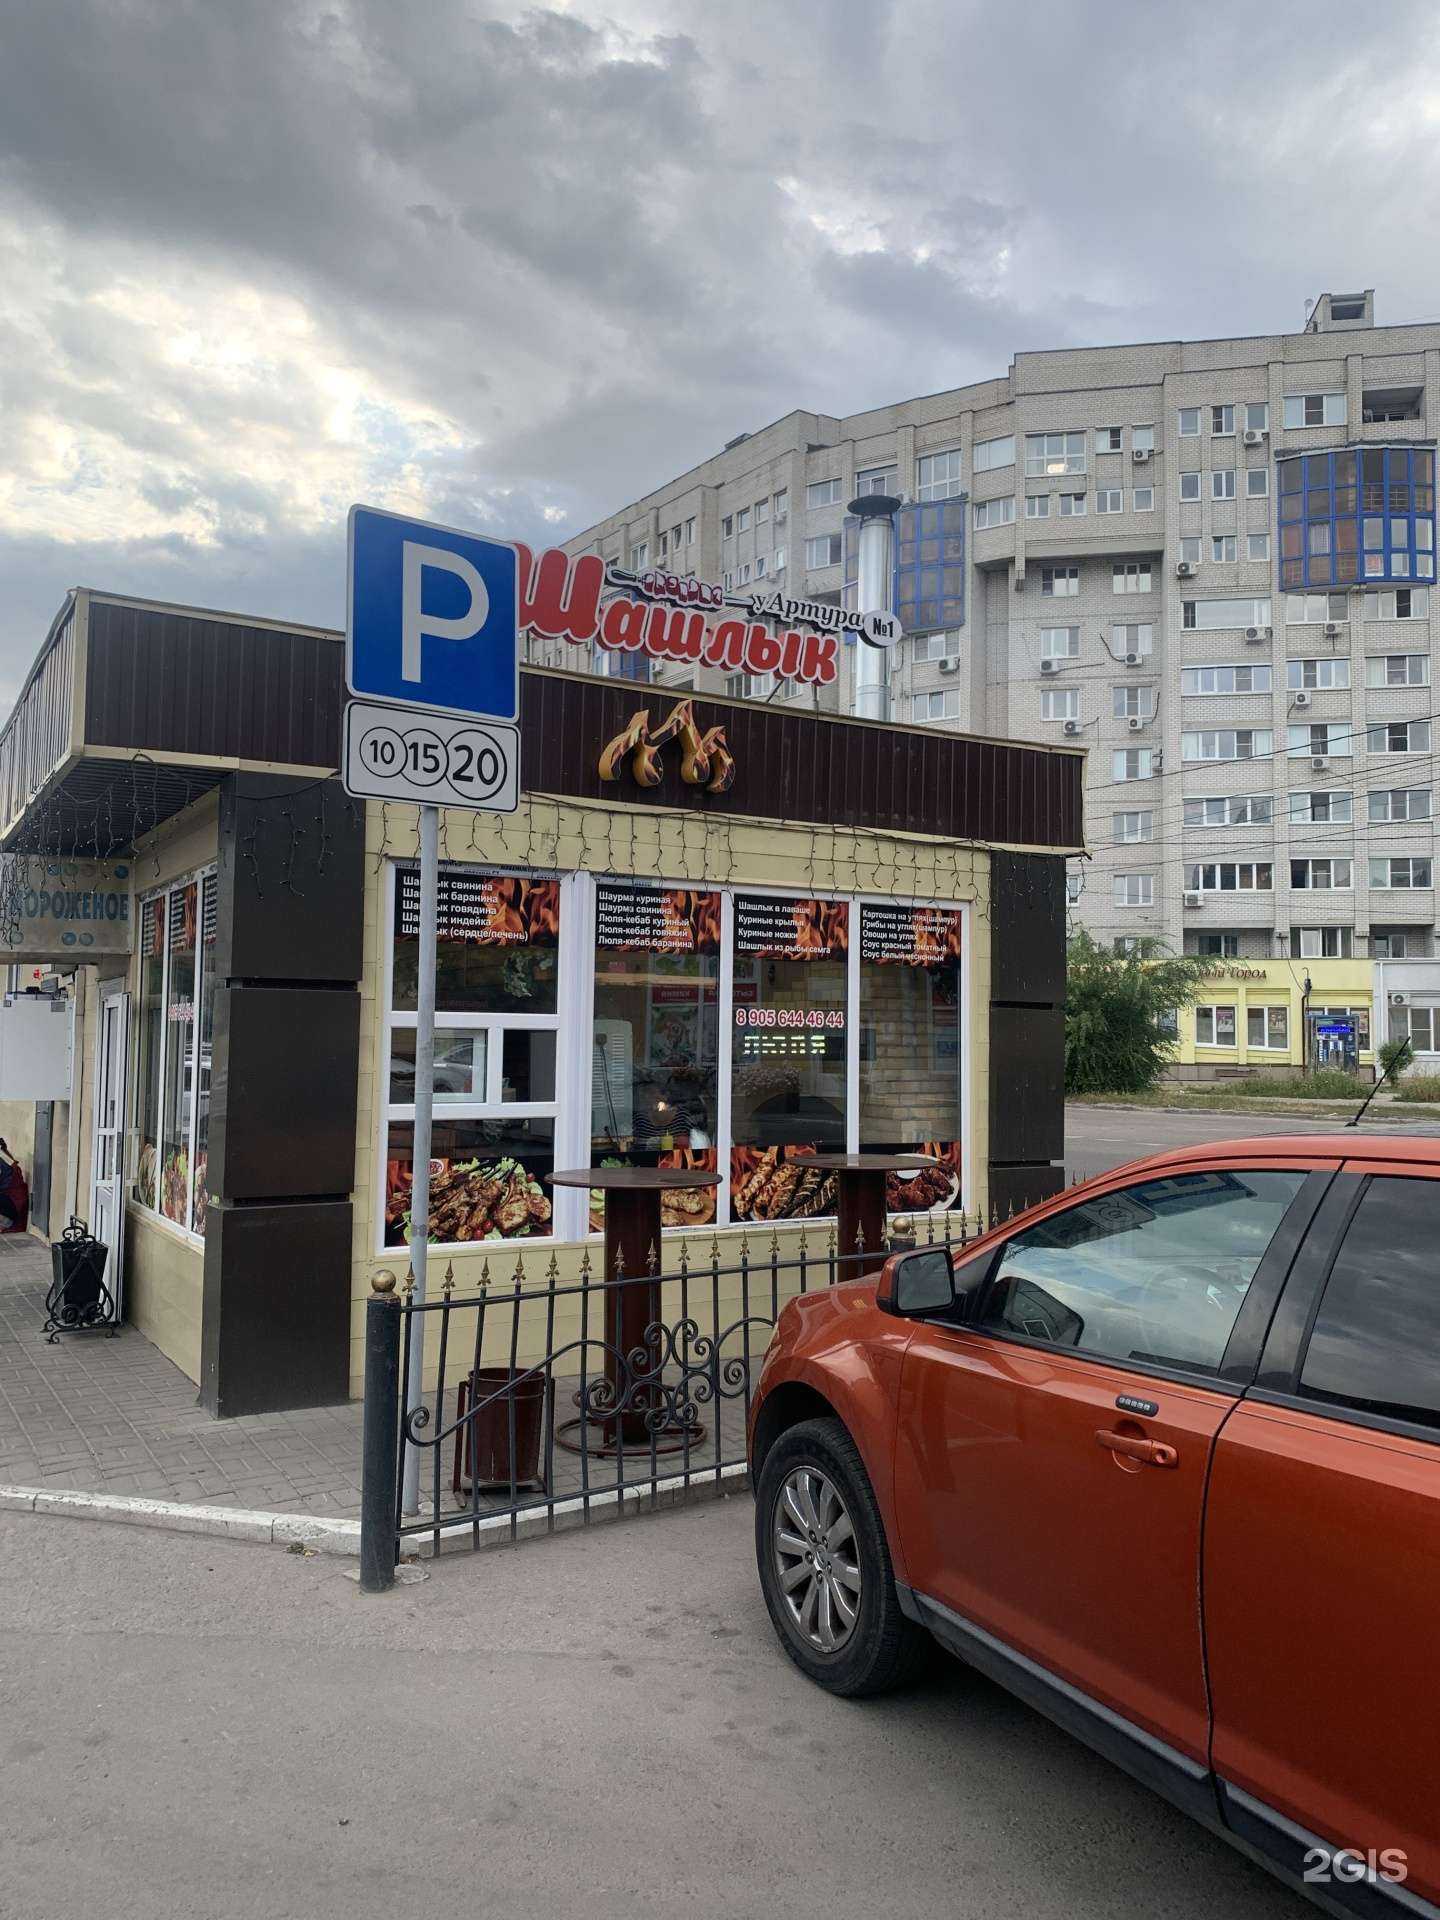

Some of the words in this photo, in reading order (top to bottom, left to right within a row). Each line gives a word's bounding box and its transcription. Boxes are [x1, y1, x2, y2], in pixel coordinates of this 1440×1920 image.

[402, 541, 490, 683] P
[518, 543, 838, 684] Шашлык
[873, 617, 894, 638] №1
[369, 739, 395, 765] 10
[408, 741, 440, 774] 15
[452, 743, 499, 785] 20
[403, 876, 449, 888] Шаык
[451, 880, 493, 892] свинина
[403, 888, 449, 900] Шаык
[451, 891, 498, 904] баранина
[598, 891, 634, 902] Шаурма
[402, 900, 449, 912] Шаык
[451, 904, 497, 916] говядина
[598, 902, 634, 913] Шаурма
[738, 901, 773, 912] Шашлык
[402, 912, 449, 924] Шаык
[451, 915, 492, 927] индейка
[598, 914, 651, 924] Люля-кебаб
[738, 915, 773, 926] Куриные
[862, 910, 896, 920] Картошка
[402, 924, 448, 936] Шаык
[598, 925, 650, 936] Люля-кебаб
[862, 920, 886, 930] Грибы
[738, 928, 773, 938] Куриные
[862, 930, 887, 939] Овощи
[598, 936, 651, 947] Люля-кебаб
[738, 941, 773, 951] Шашлык
[862, 940, 880, 949] Соус
[862, 950, 880, 959] Соус
[736, 1008, 746, 1025] 8
[748, 1008, 776, 1026] 905
[777, 1009, 804, 1027] 644
[806, 1010, 824, 1028] 46
[826, 1011, 844, 1028] 44
